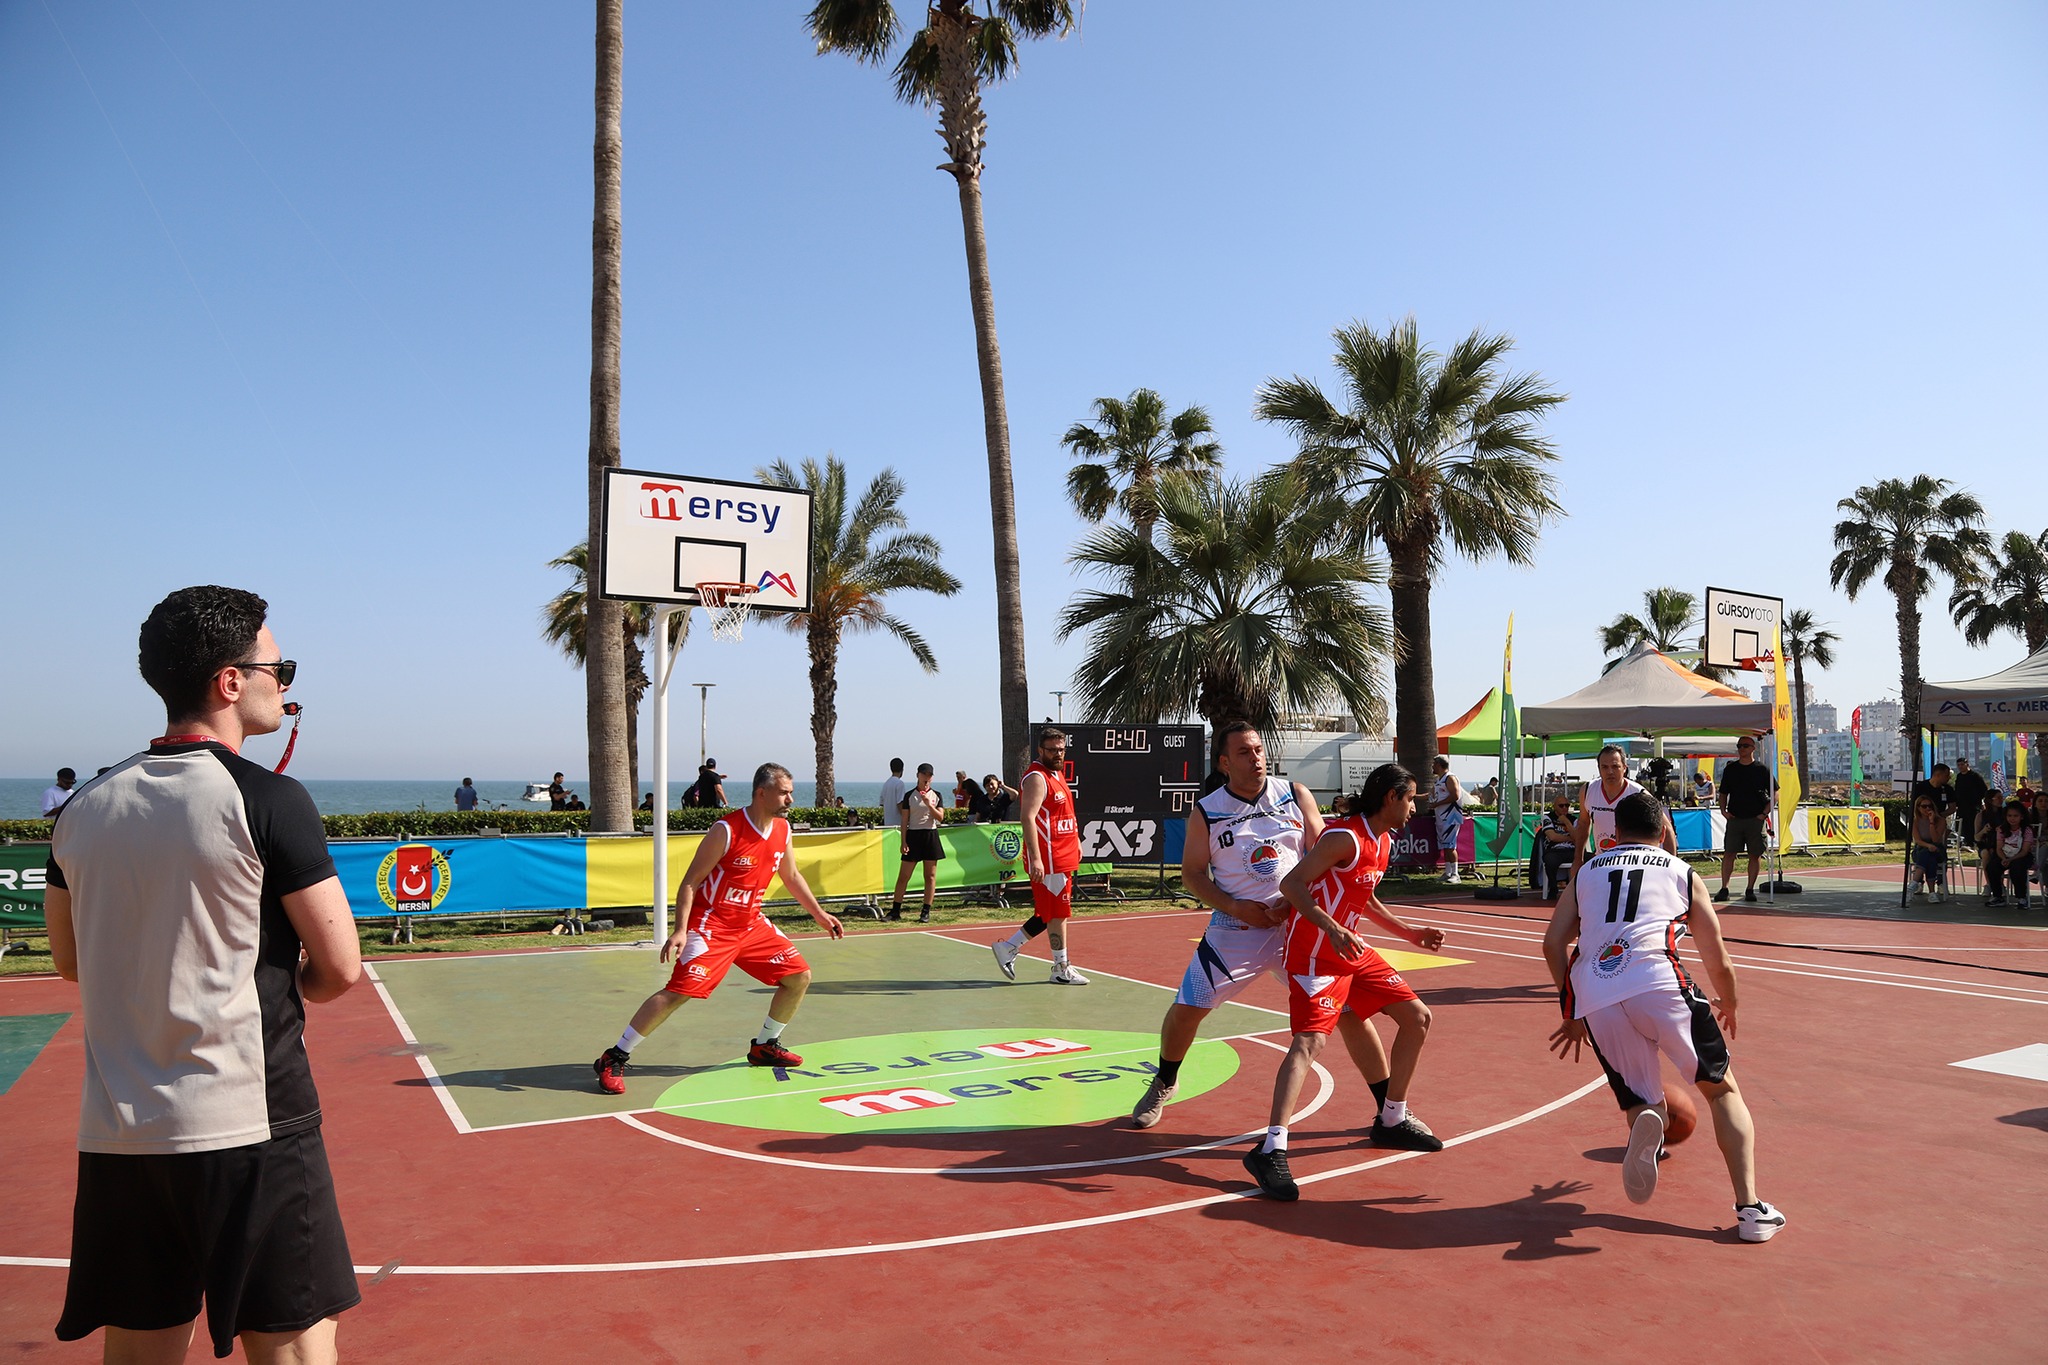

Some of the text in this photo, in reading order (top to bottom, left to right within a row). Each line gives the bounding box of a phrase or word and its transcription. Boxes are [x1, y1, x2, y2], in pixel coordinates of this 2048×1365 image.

[640, 482, 781, 533] mersy
[1717, 600, 1774, 623] GÜRSOYOTO
[1984, 702, 2011, 713] T.C.
[1105, 729, 1146, 750] 8:40
[1164, 735, 1186, 748] GUEST
[1057, 819, 1074, 832] KZV
[1217, 830, 1235, 849] 10
[1590, 852, 1671, 871] MUHİTTİN ÖZEN
[725, 886, 753, 905] KZV
[1605, 869, 1645, 923] 11
[398, 901, 430, 911] MERSİN
